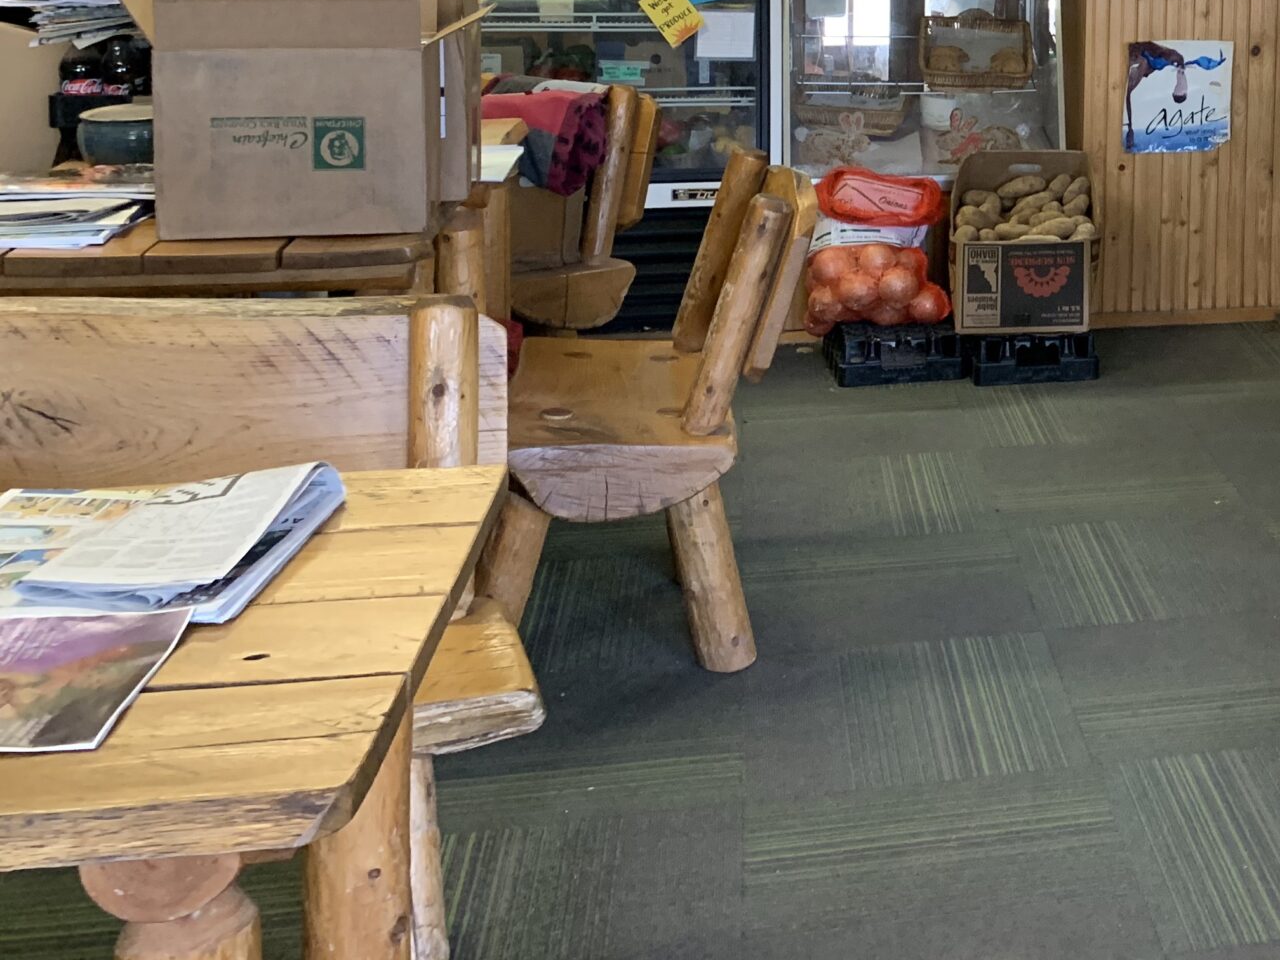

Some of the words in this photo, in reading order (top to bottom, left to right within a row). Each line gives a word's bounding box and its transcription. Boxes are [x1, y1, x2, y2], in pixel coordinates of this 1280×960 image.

[658, 6, 693, 33] PRODUCE
[660, 1, 675, 17] got
[1145, 93, 1228, 140] agate
[232, 129, 309, 150] Chieftain
[879, 195, 909, 210] Onions
